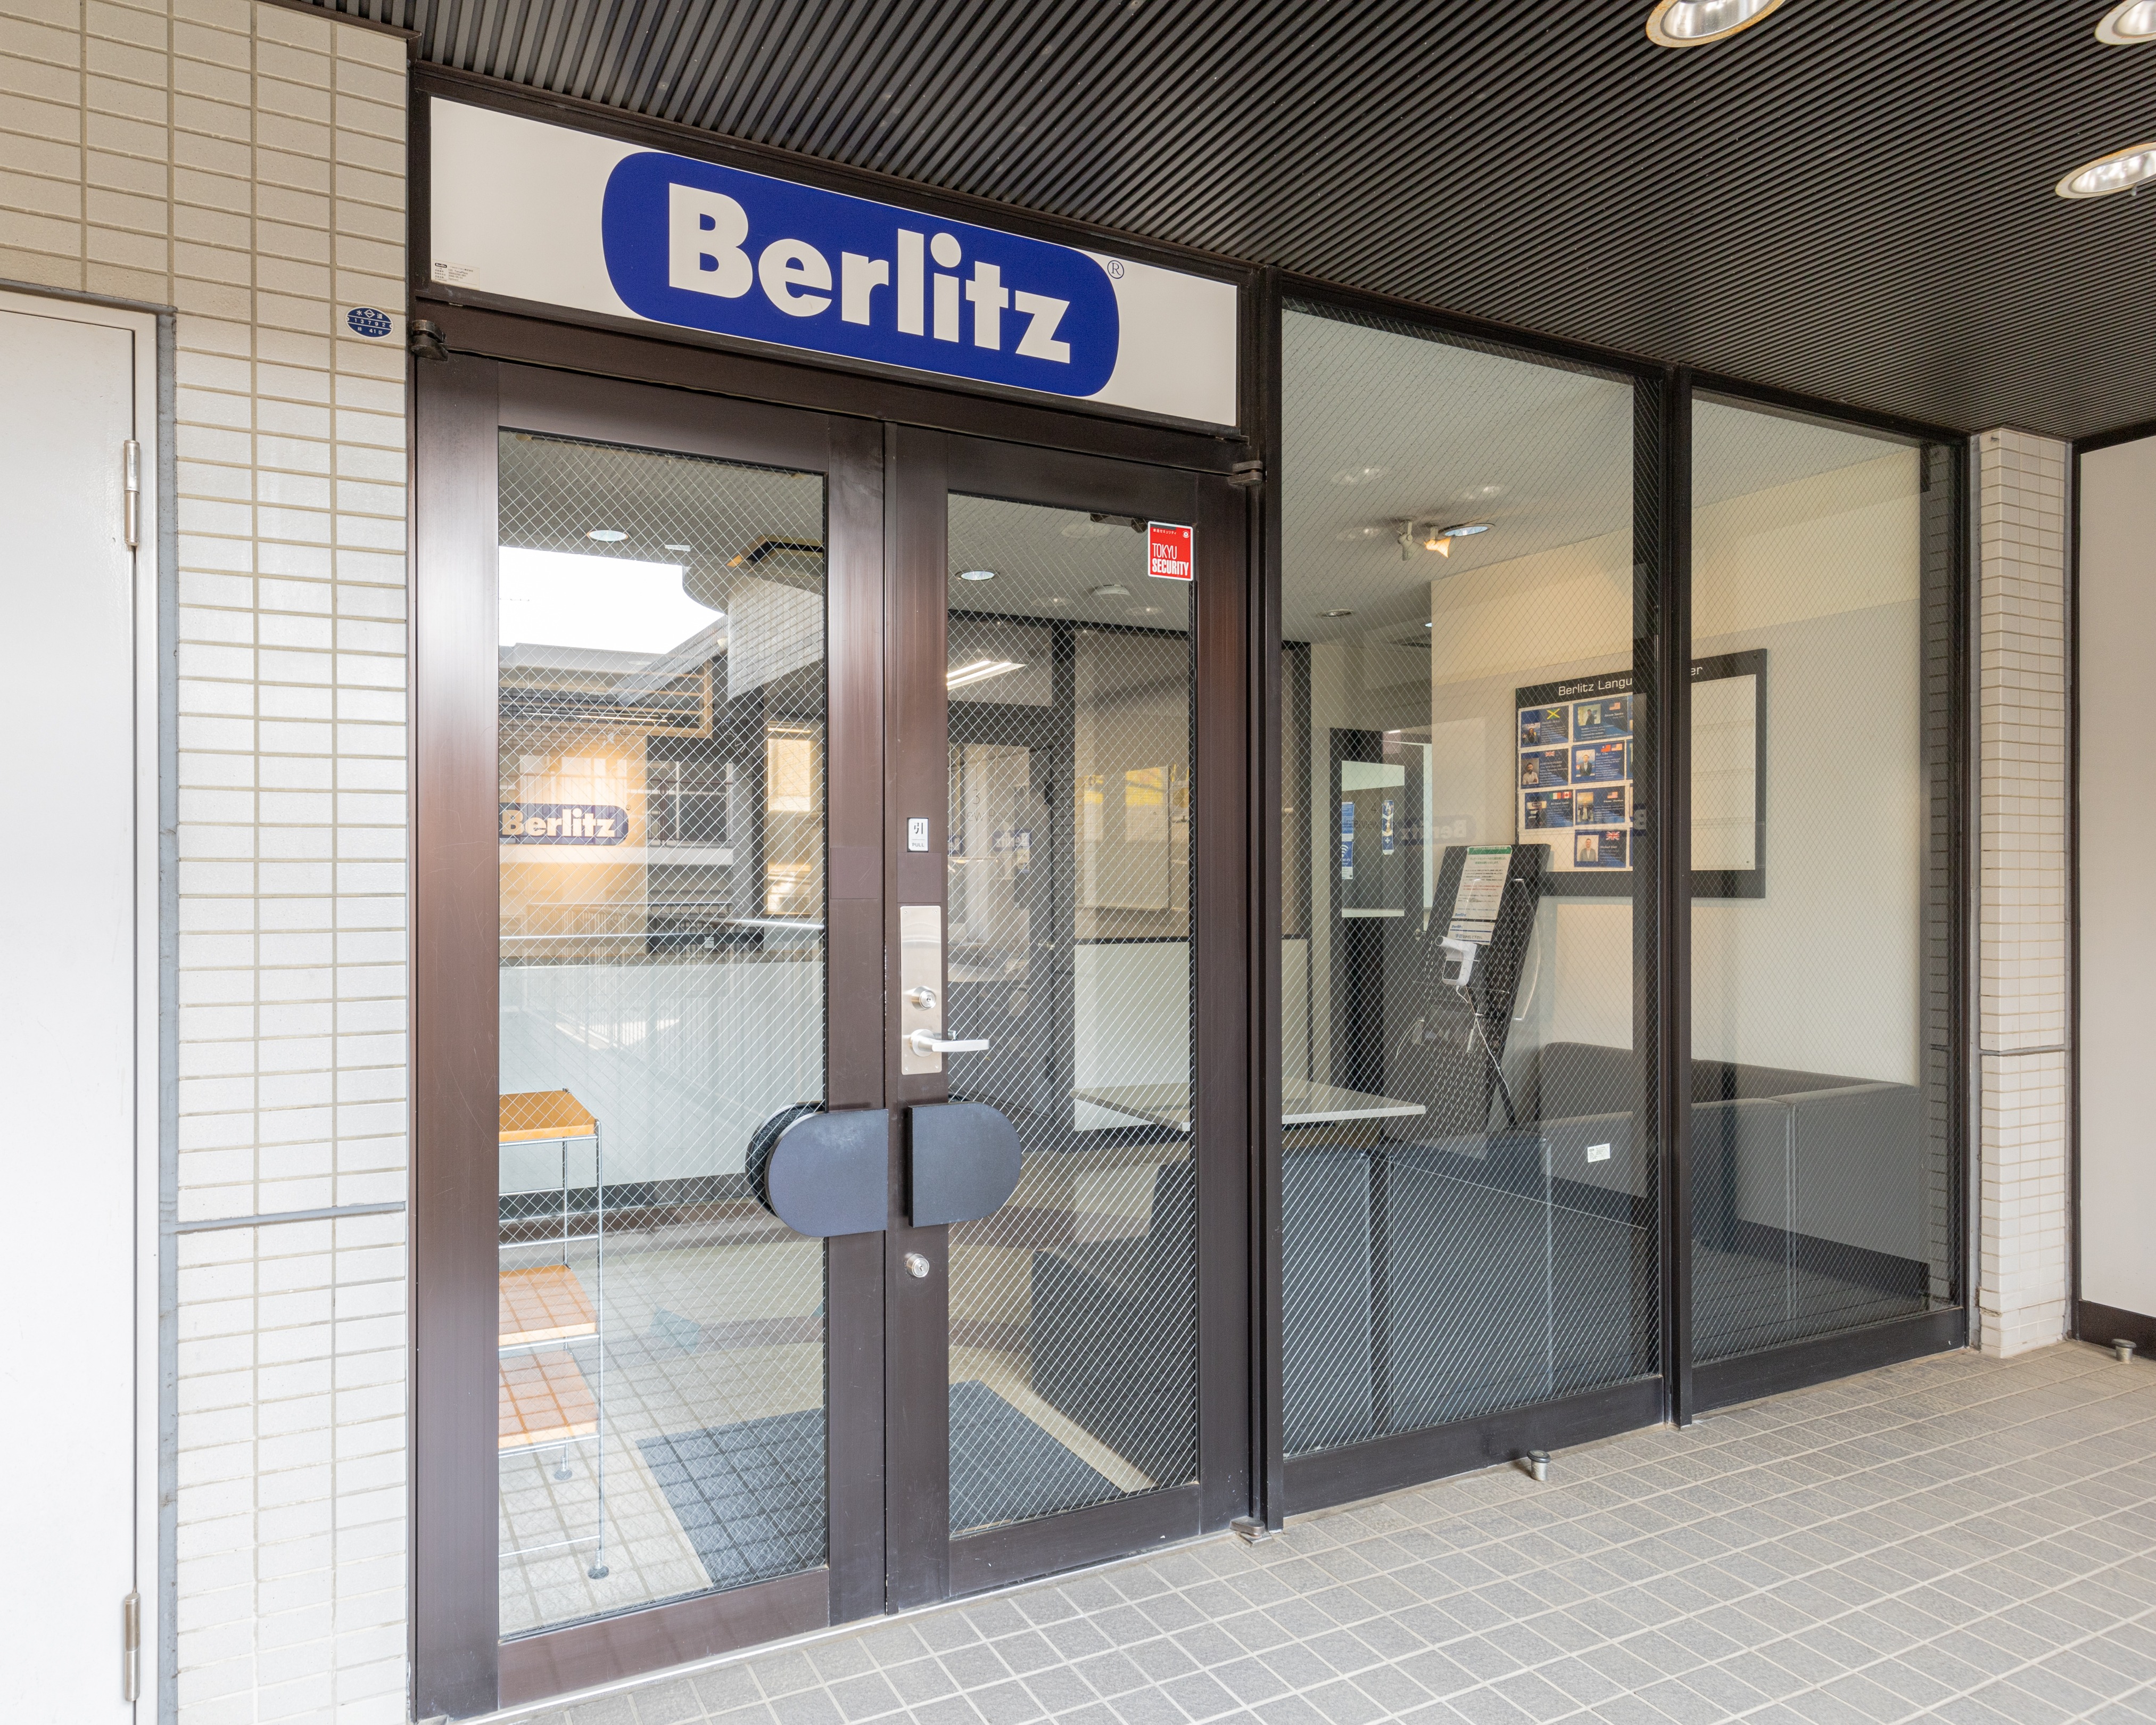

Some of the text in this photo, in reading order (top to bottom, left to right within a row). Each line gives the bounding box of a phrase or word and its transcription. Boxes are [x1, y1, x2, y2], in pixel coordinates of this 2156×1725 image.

[669, 182, 1070, 364] Berlitz
[354, 318, 385, 327] 13792
[1152, 543, 1177, 559] TOKYU
[1152, 558, 1189, 576] SECURITY
[1558, 678, 1632, 696] Berlitz Langu
[502, 808, 615, 837] Berlitz
[914, 822, 923, 834] 引
